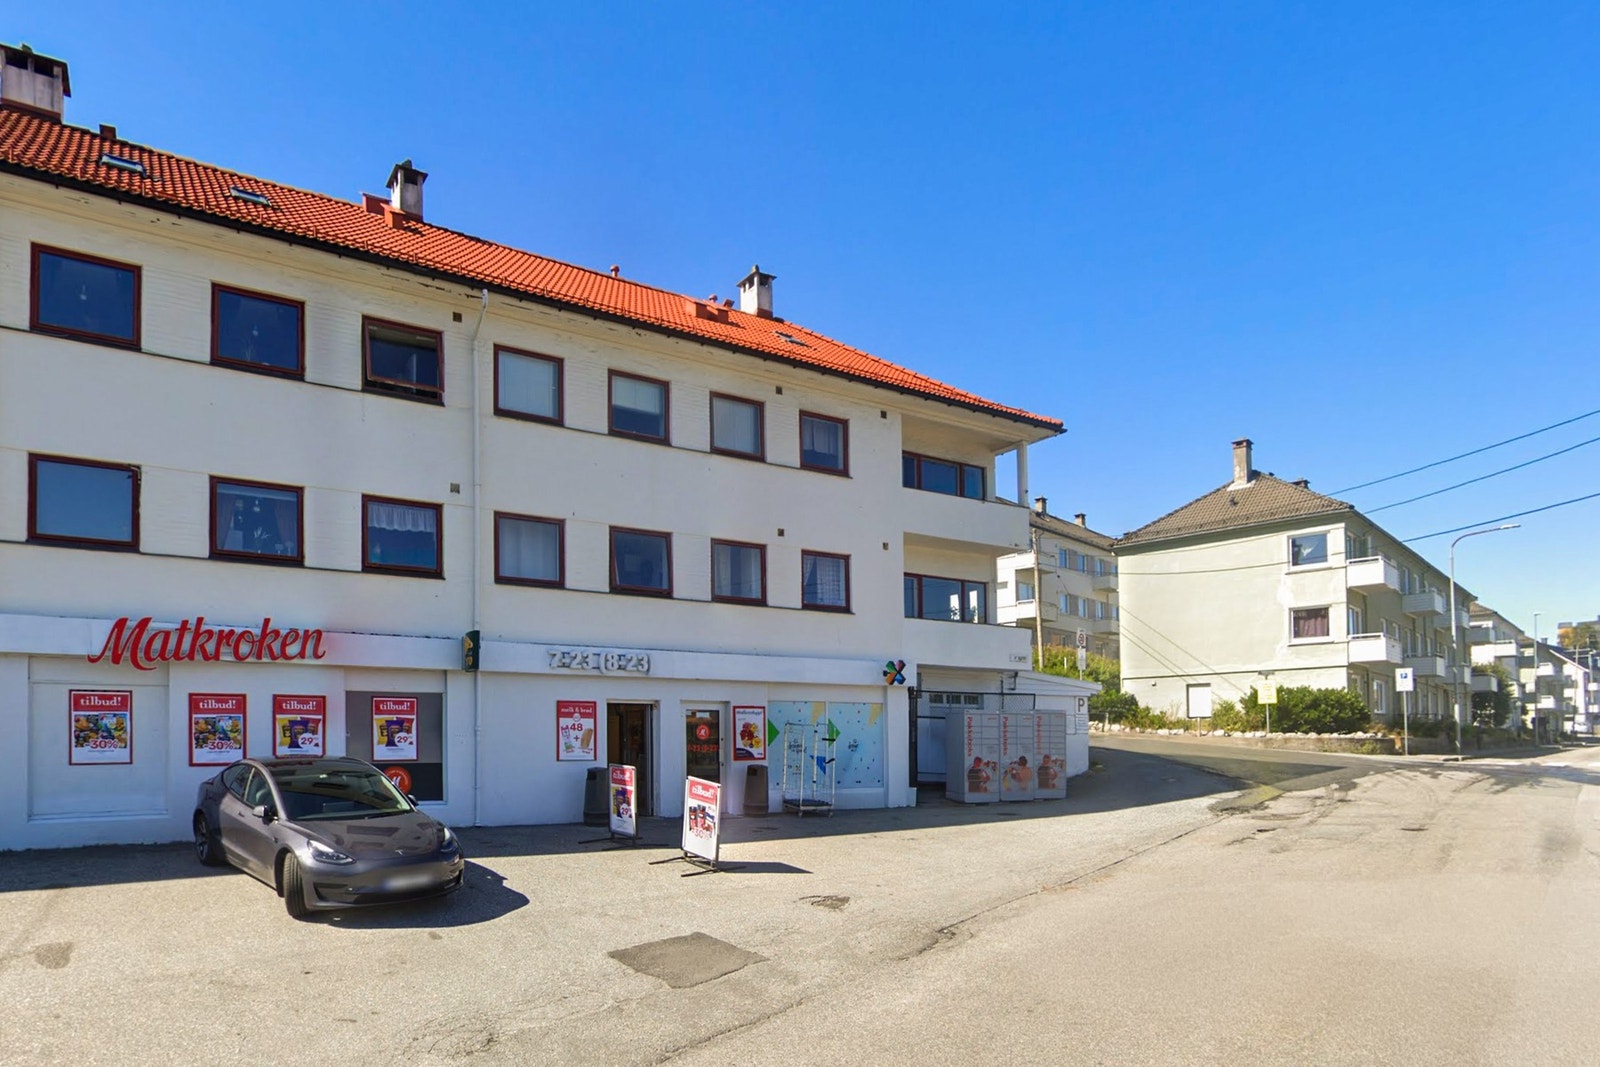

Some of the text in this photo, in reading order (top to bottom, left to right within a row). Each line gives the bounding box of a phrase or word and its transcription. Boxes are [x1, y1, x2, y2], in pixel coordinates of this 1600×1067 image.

[87, 616, 326, 671] Matkroken
[80, 697, 121, 706] tilbud!
[199, 700, 237, 709] tilbud!
[282, 701, 317, 710] tilbud!
[1078, 697, 1085, 712] P
[380, 702, 411, 711] tilbud!
[570, 723, 583, 731] 48
[84, 739, 119, 749] -30%
[203, 741, 235, 750] -30%
